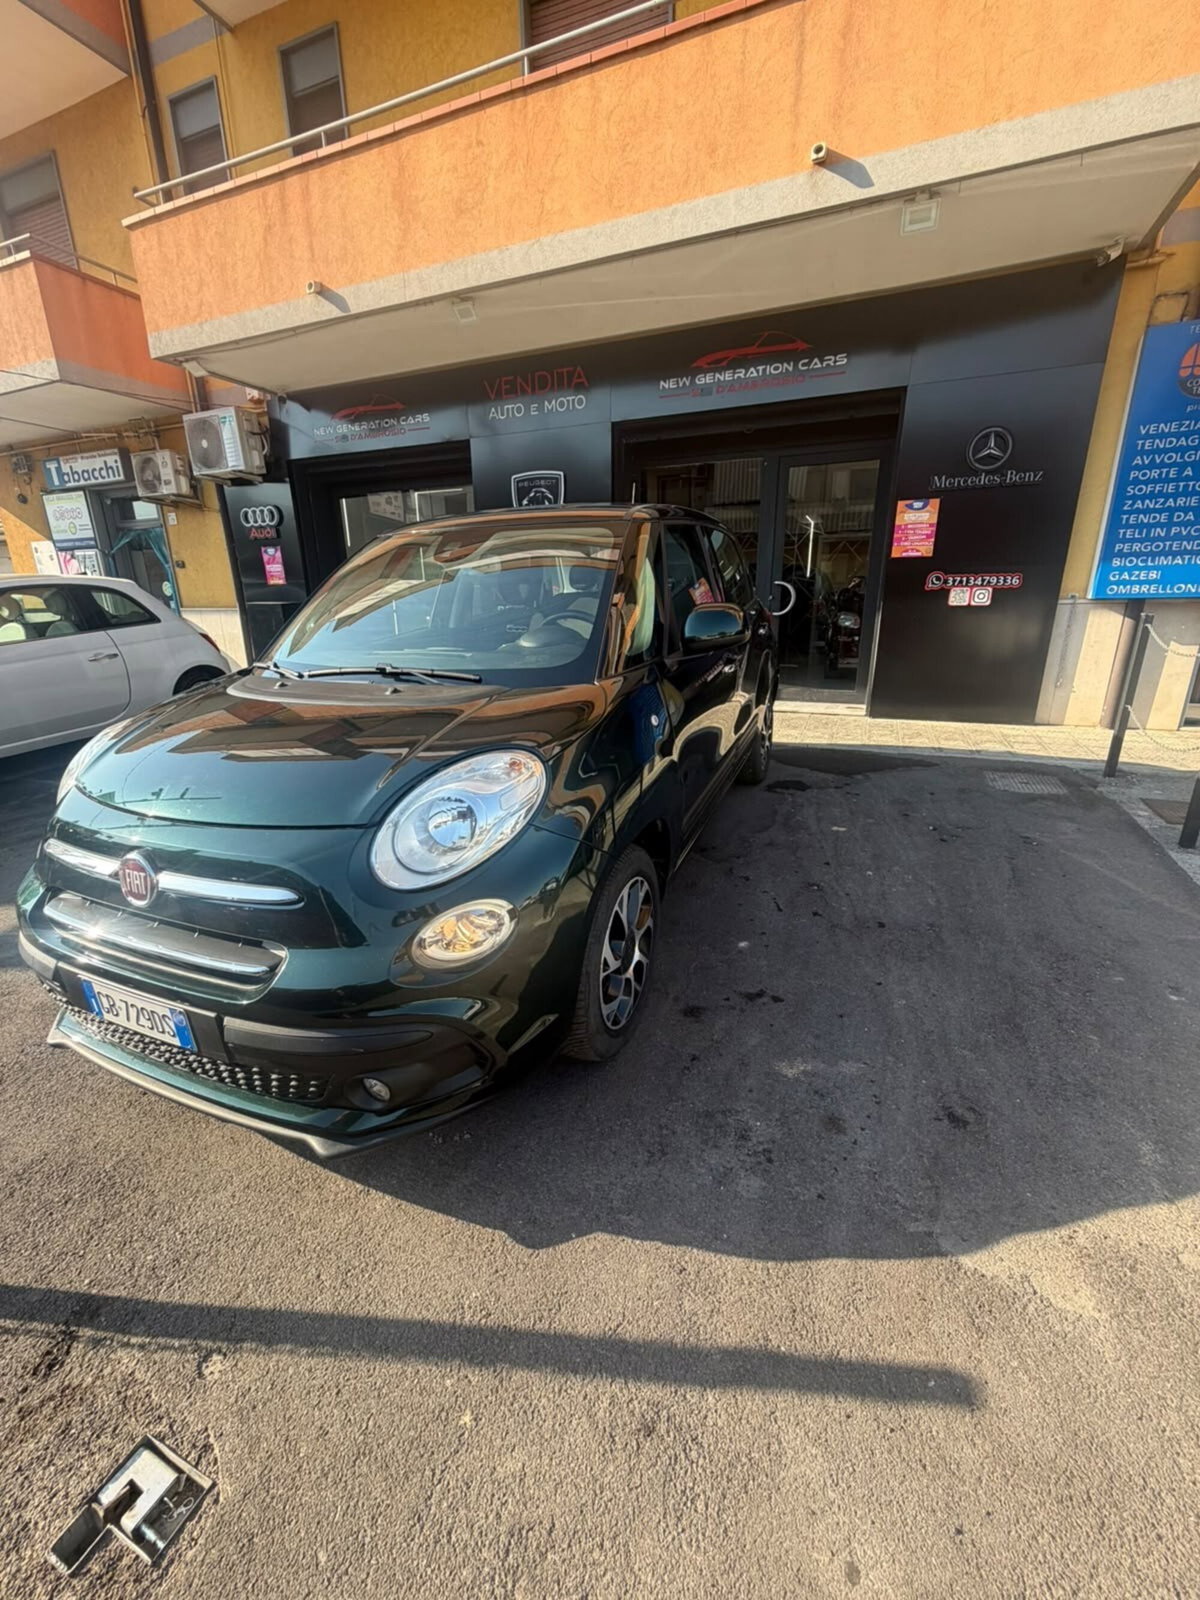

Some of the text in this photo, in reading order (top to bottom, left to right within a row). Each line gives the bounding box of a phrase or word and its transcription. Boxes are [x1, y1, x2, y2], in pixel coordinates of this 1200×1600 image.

[659, 353, 848, 390] NEW GENERATION CARS
[482, 365, 590, 401] VENDITA
[488, 395, 586, 420] AUTO E MOTO
[313, 412, 431, 437] NEW GENERATION CARS
[1136, 435, 1199, 450] TENDAG
[45, 459, 121, 486] Tabacchi
[932, 469, 1044, 489] Mercedes-Benz
[1129, 466, 1193, 481] PORTE A
[1123, 496, 1200, 511] ZANZARIE
[1120, 511, 1195, 525] TENDE DA
[1117, 525, 1200, 539] TELI IN PVC
[946, 575, 1020, 587] 3713479336
[1109, 570, 1161, 581] GAZEBI
[125, 869, 146, 895] FIAT
